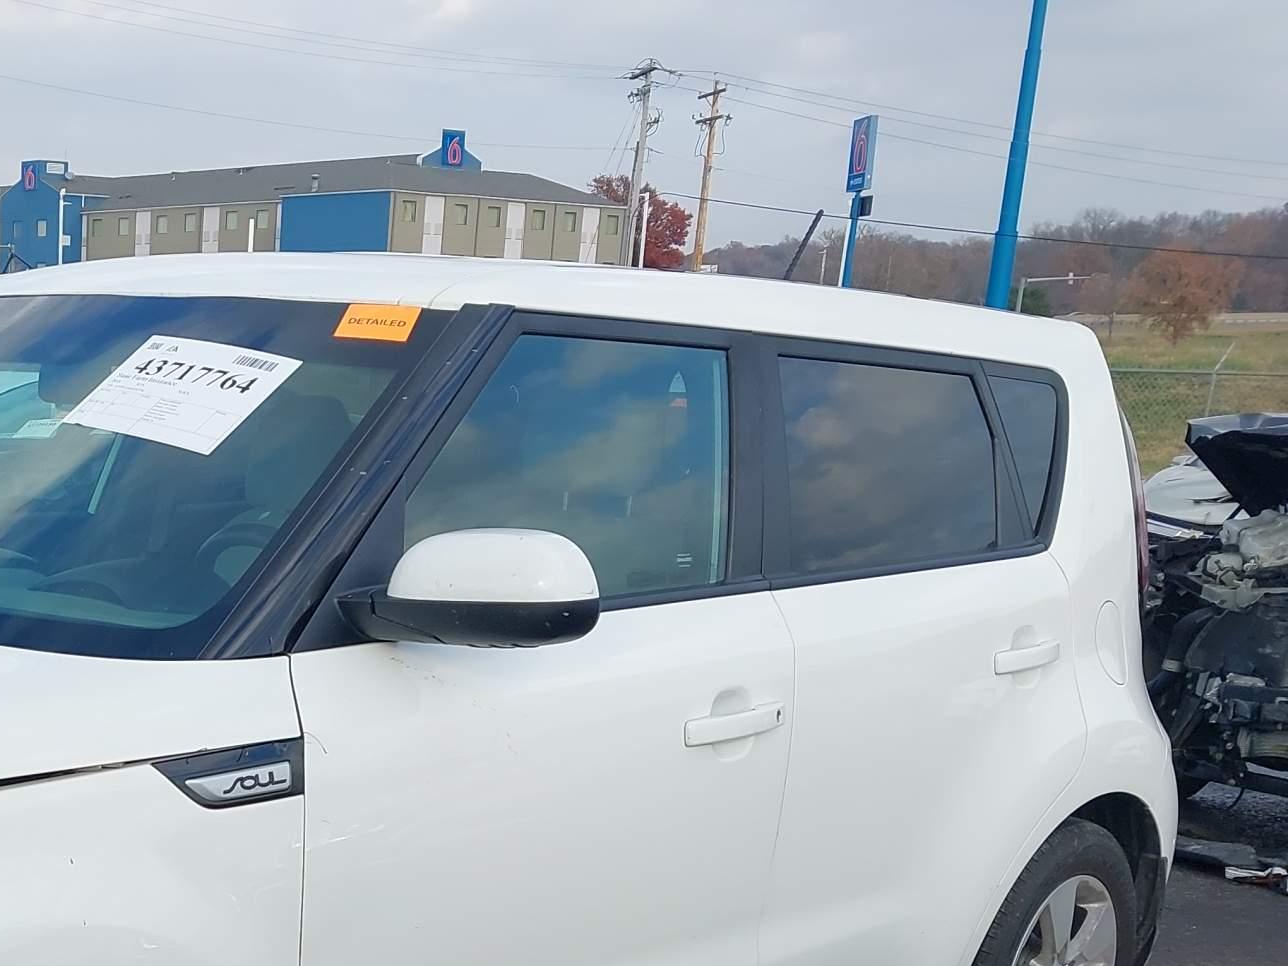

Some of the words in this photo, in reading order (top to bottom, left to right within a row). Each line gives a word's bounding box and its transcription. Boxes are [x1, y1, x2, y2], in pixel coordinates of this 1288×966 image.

[447, 136, 462, 165] 6
[854, 119, 867, 173] 6
[24, 164, 35, 190] 6
[348, 317, 406, 327] DETAILED
[134, 358, 259, 394] 43717764
